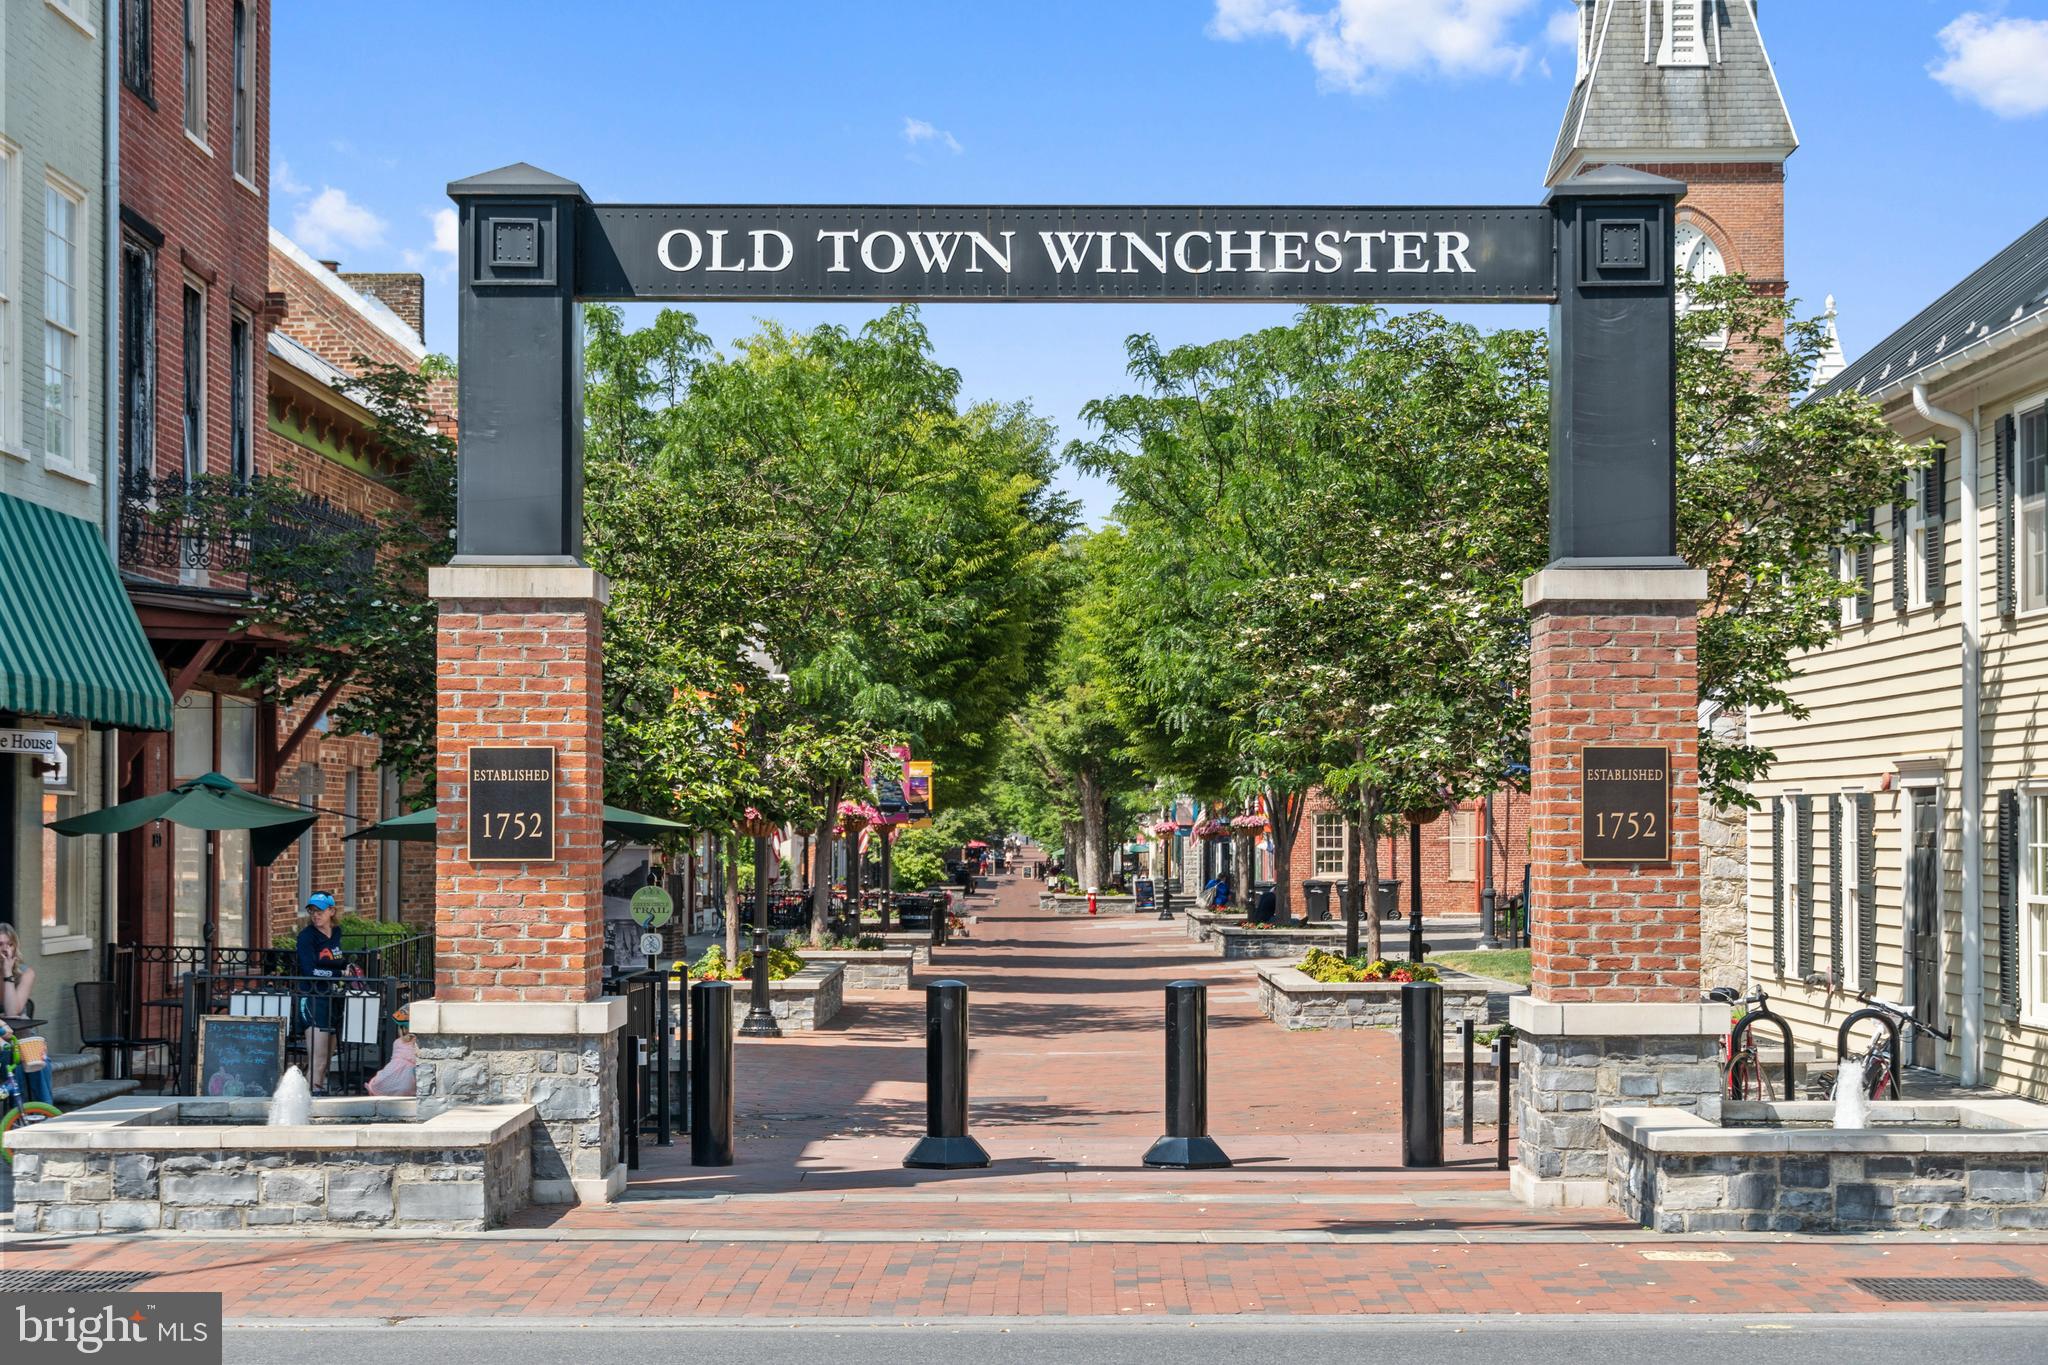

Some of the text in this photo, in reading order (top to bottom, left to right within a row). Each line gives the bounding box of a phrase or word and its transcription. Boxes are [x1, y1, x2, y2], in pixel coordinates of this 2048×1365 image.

[657, 229, 1477, 274] OLD TOWN WINCHESTER
[11, 733, 53, 750] House
[473, 769, 550, 782] ESTABLISHED
[1587, 768, 1664, 781] ESTABLISHED
[482, 812, 543, 840] 1752
[1596, 811, 1657, 840] 1752
[632, 906, 670, 914] TRAIL
